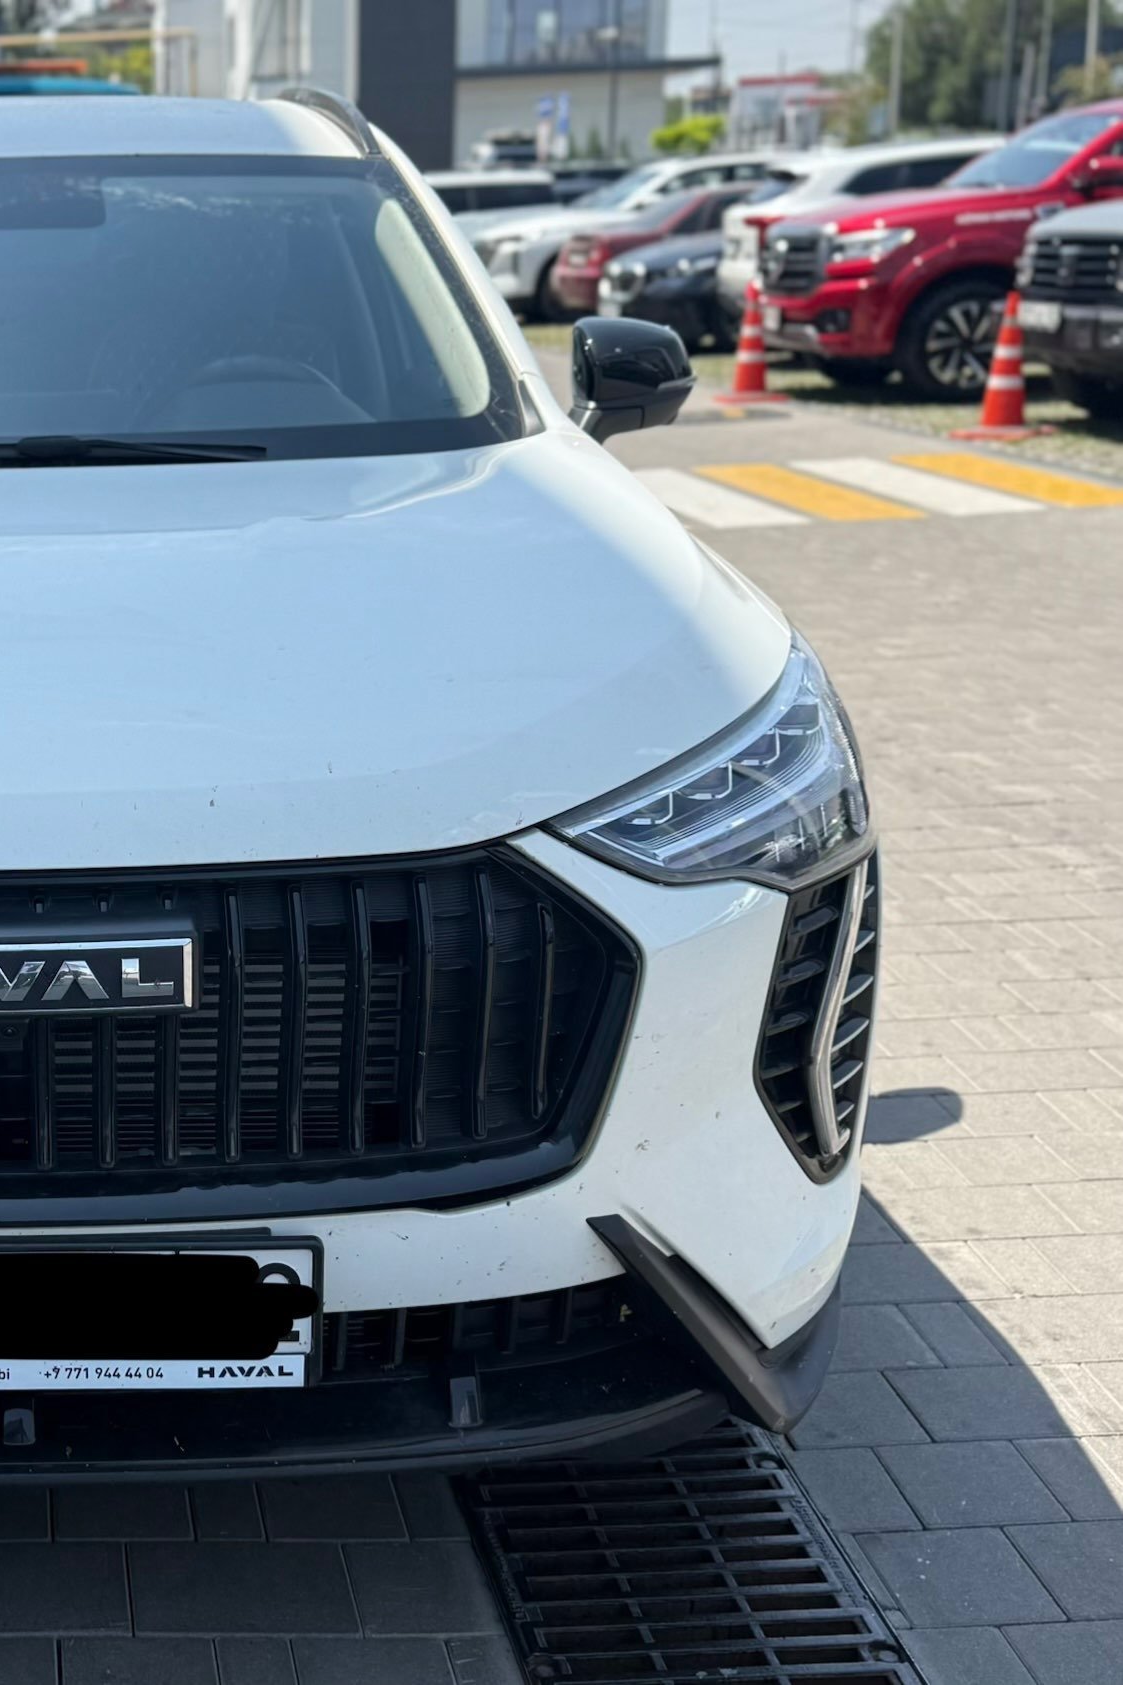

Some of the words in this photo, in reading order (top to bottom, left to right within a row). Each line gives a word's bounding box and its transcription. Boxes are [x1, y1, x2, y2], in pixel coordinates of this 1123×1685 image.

[64, 1367, 89, 1379] 771
[94, 1367, 121, 1379] 944
[124, 1367, 142, 1379] 44
[146, 1367, 164, 1379] 04
[197, 1365, 294, 1378] HAVAL
